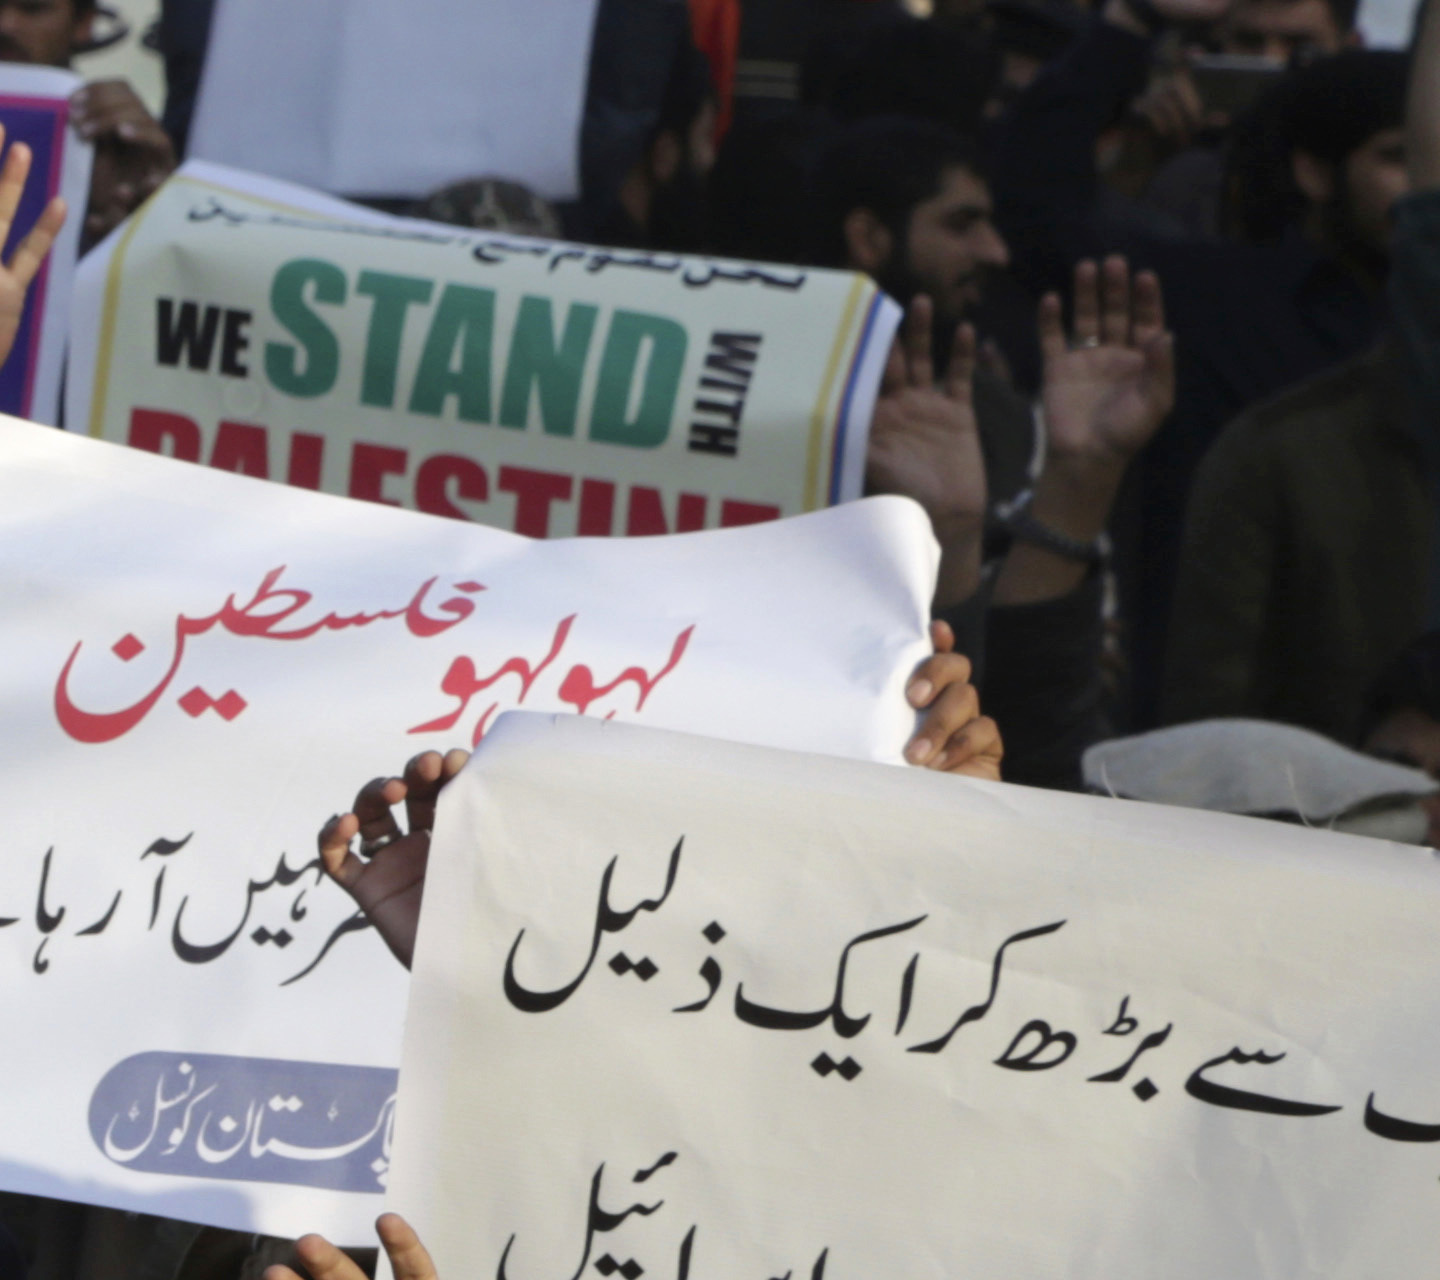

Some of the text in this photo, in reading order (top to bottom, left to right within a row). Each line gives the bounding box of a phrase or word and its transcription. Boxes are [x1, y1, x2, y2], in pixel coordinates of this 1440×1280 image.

[154, 256, 765, 460] WE STAND WITH
[52, 563, 489, 745] فلسطین
[500, 830, 728, 1016] ذلیل
[731, 912, 931, 1084] ایک
[903, 918, 1071, 1056] کر
[989, 992, 1175, 1104] بڑھ
[1180, 1044, 1346, 1118] سے
